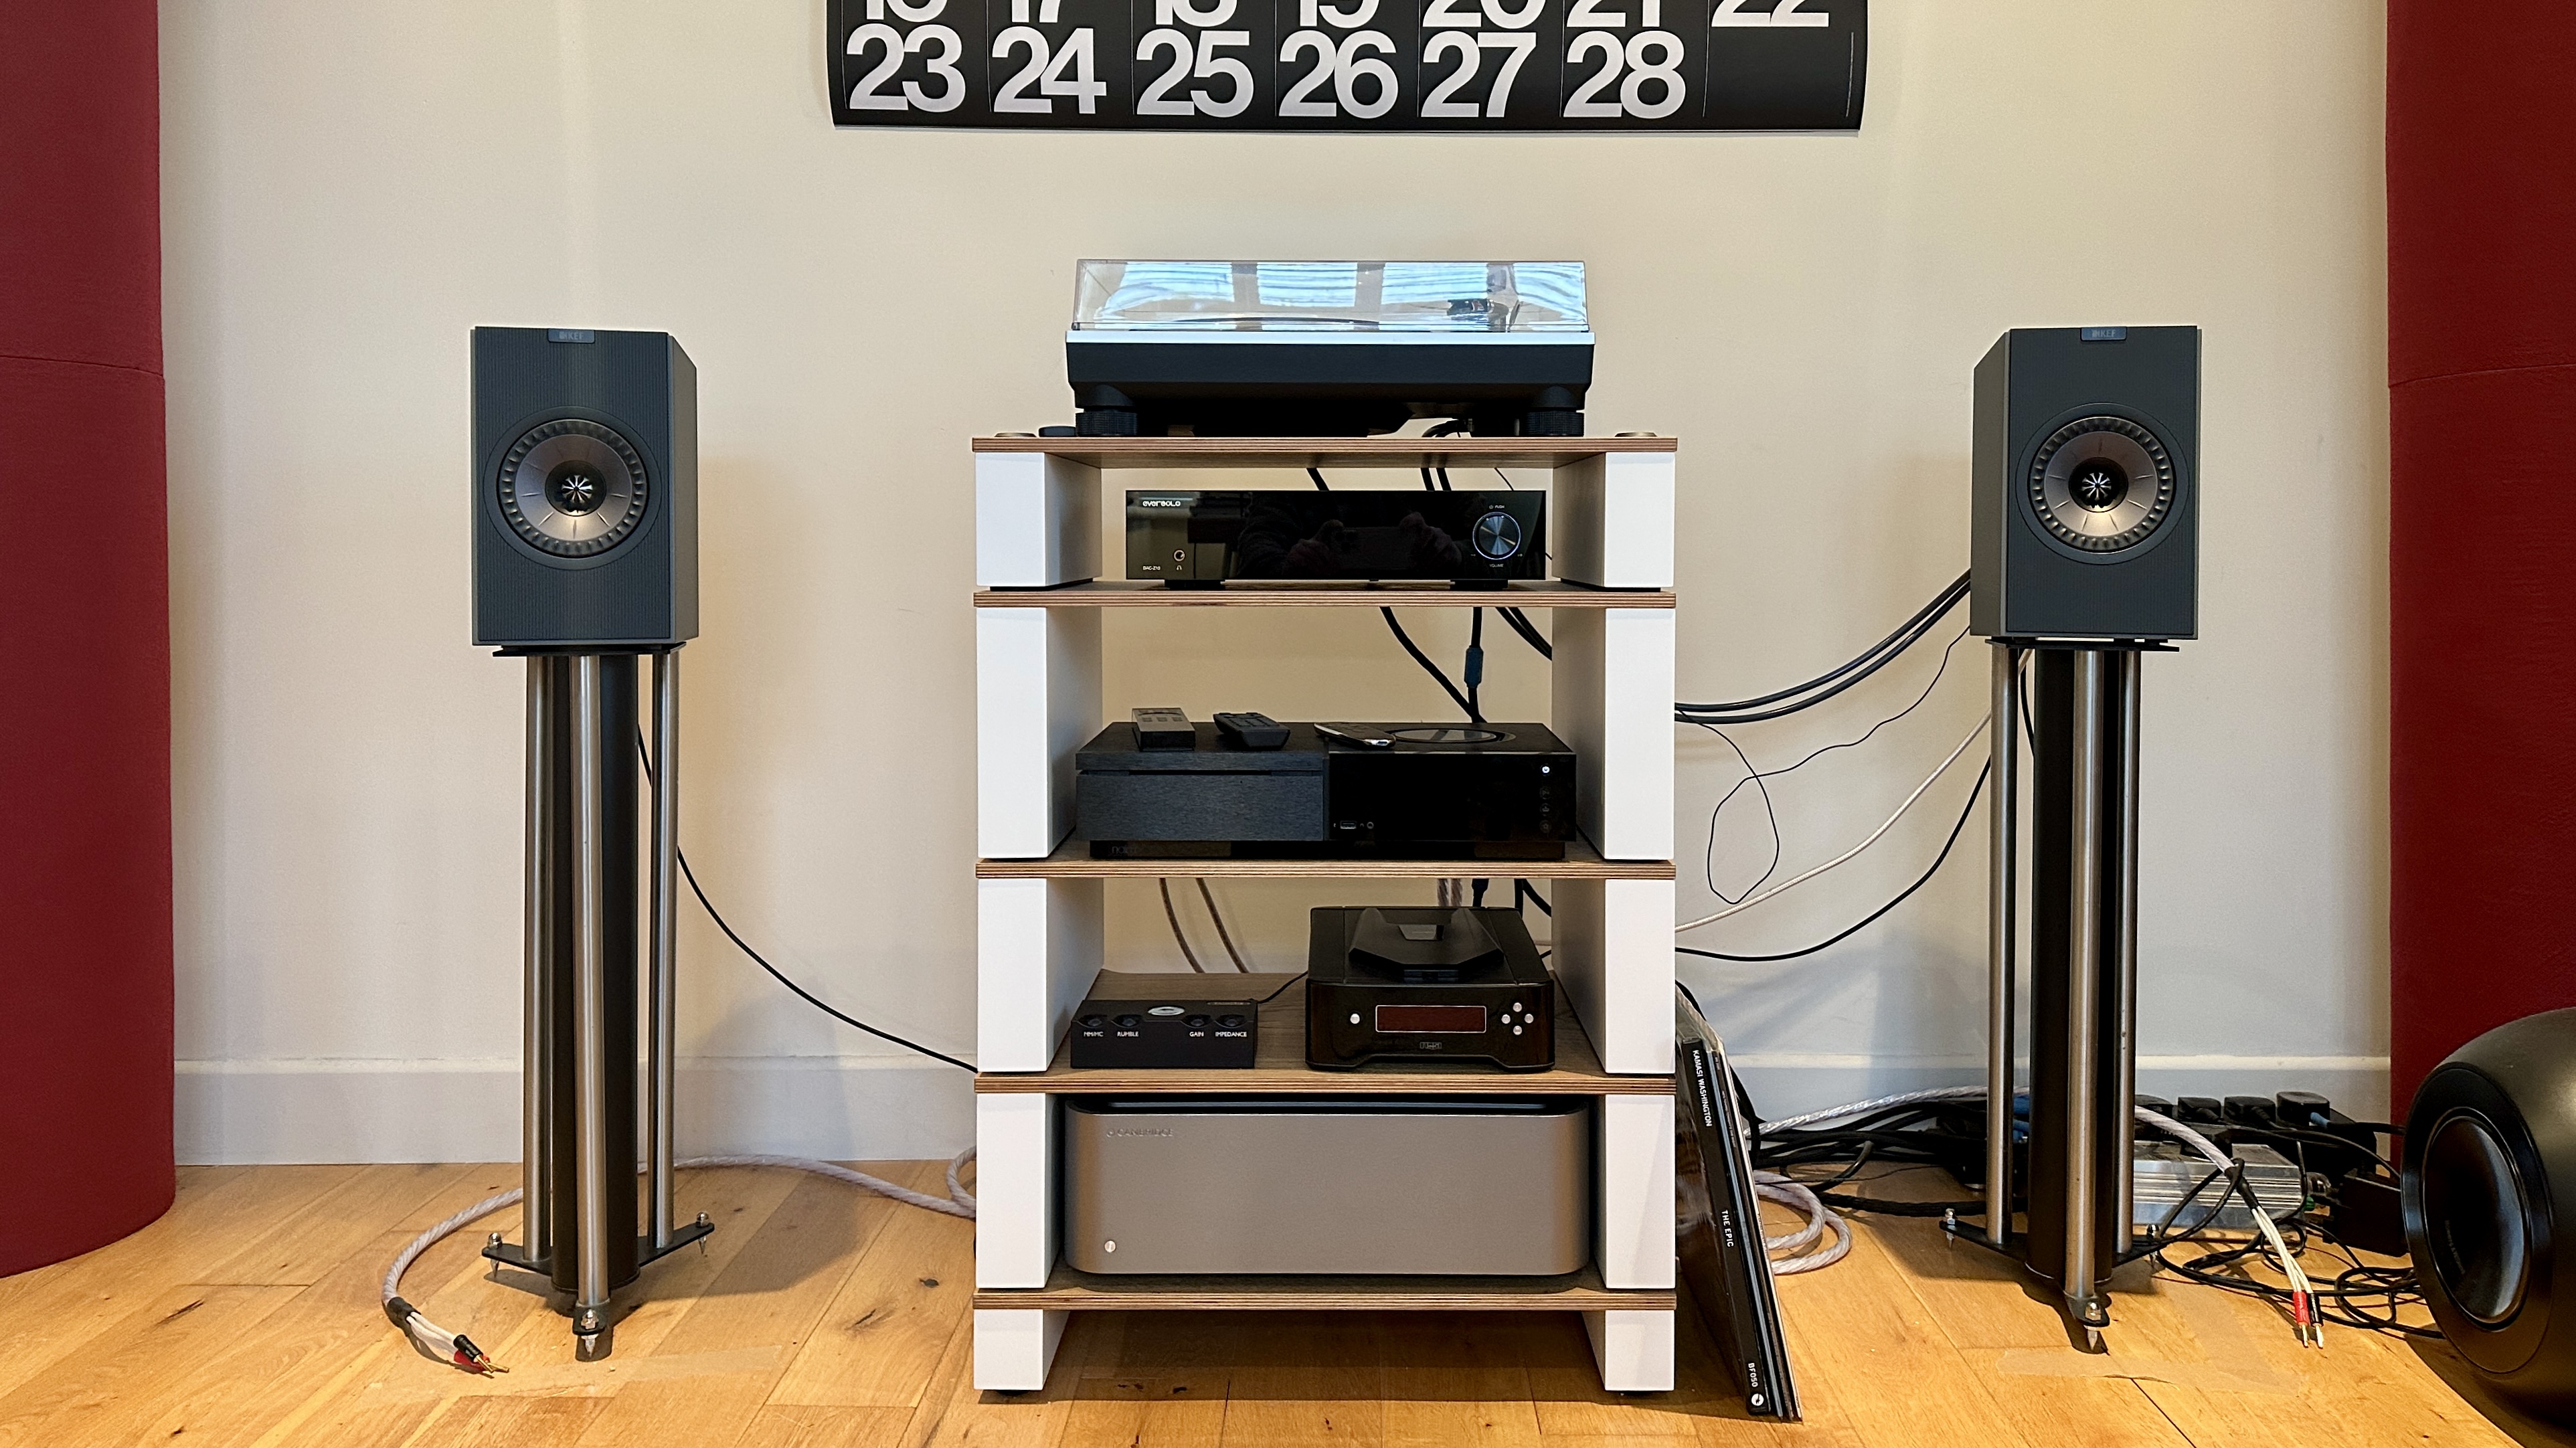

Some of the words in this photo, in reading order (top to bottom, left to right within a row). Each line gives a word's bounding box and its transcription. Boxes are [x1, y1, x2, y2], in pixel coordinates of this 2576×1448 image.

[847, 23, 966, 112] 23
[992, 26, 1106, 114] 24
[1136, 29, 1254, 118] 25
[1279, 30, 1398, 118] 26
[1421, 31, 1537, 117] 27
[1563, 31, 1686, 118] 28
[1693, 1050, 1703, 1077] KAMASI
[1698, 1078, 1713, 1127] WASHINGTON
[1721, 1210, 1731, 1226] THE
[1725, 1228, 1734, 1247] EPIC
